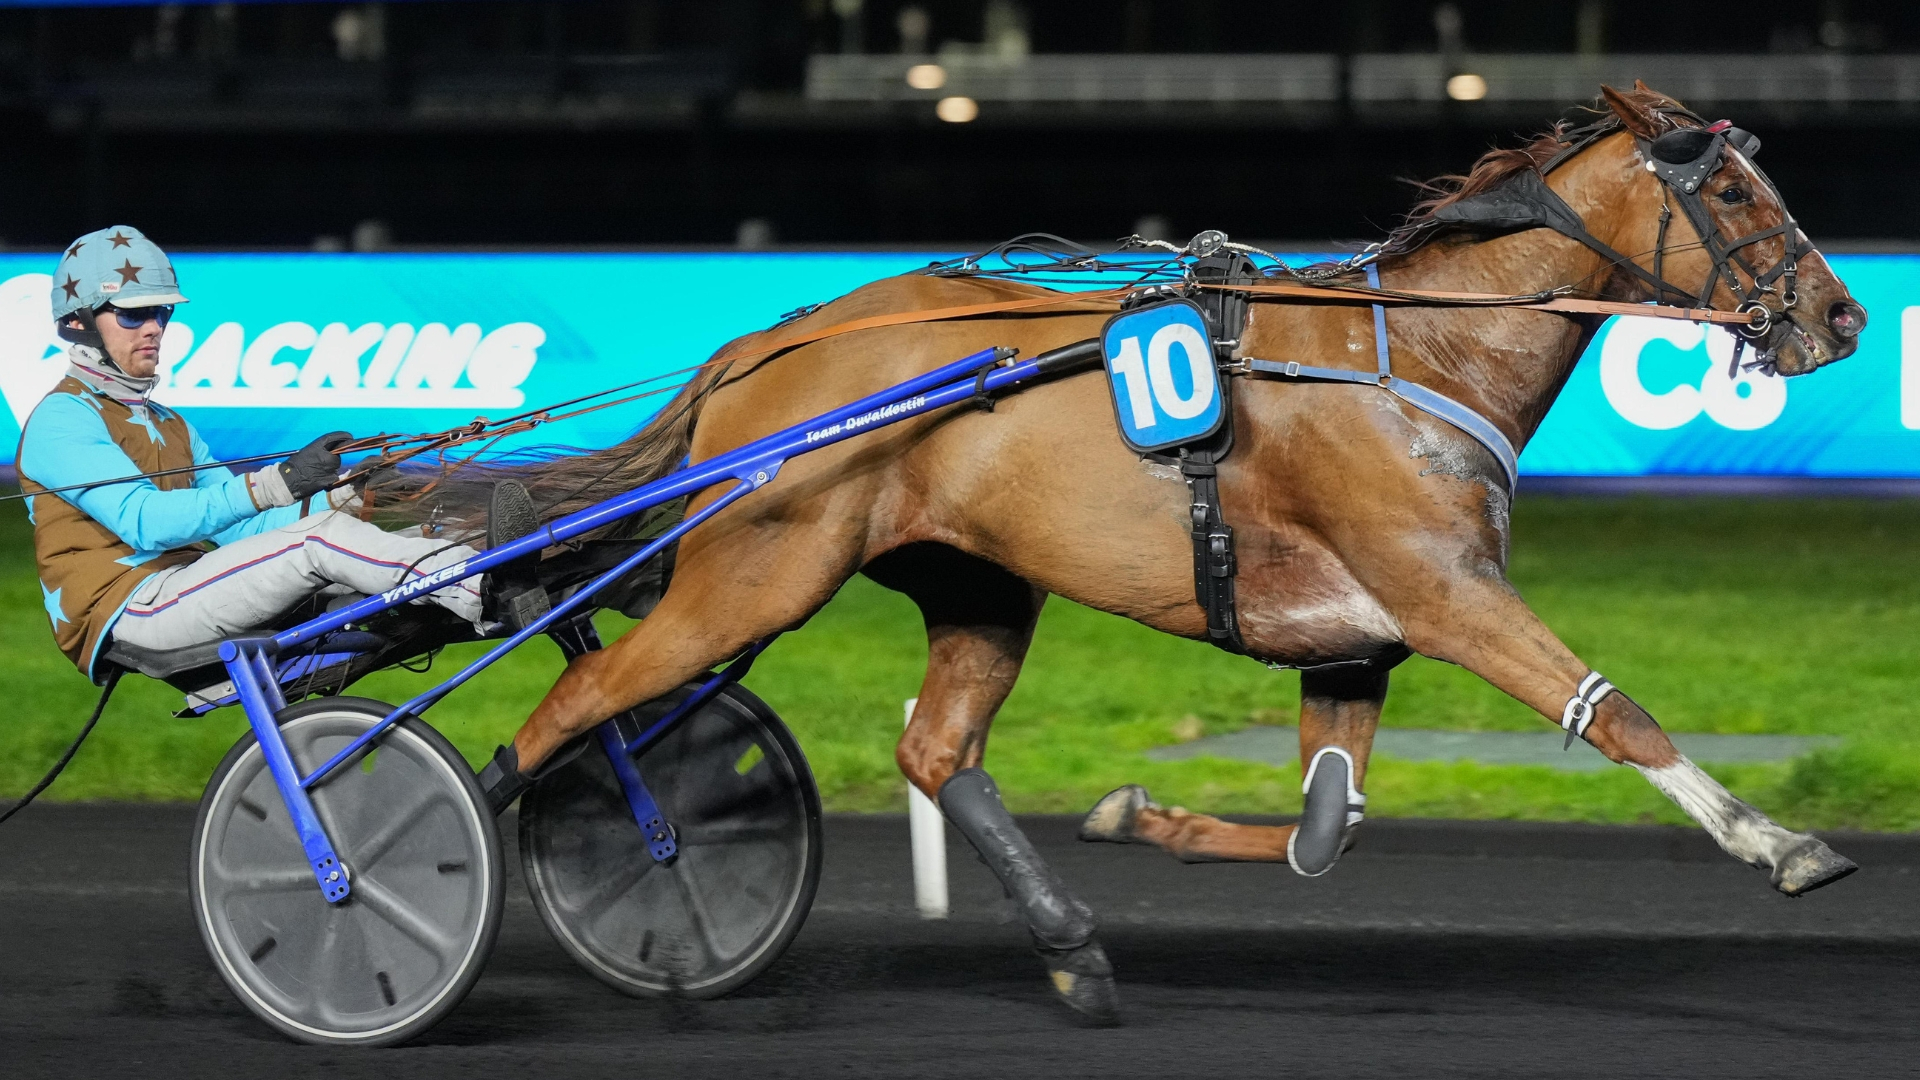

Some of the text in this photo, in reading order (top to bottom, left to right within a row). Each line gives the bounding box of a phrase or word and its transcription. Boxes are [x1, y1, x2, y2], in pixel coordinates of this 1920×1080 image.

[154, 321, 546, 389] RACKING
[1110, 323, 1214, 430] 10
[806, 395, 926, 444] Team Duvaldestin
[382, 560, 468, 604] YANKEE
